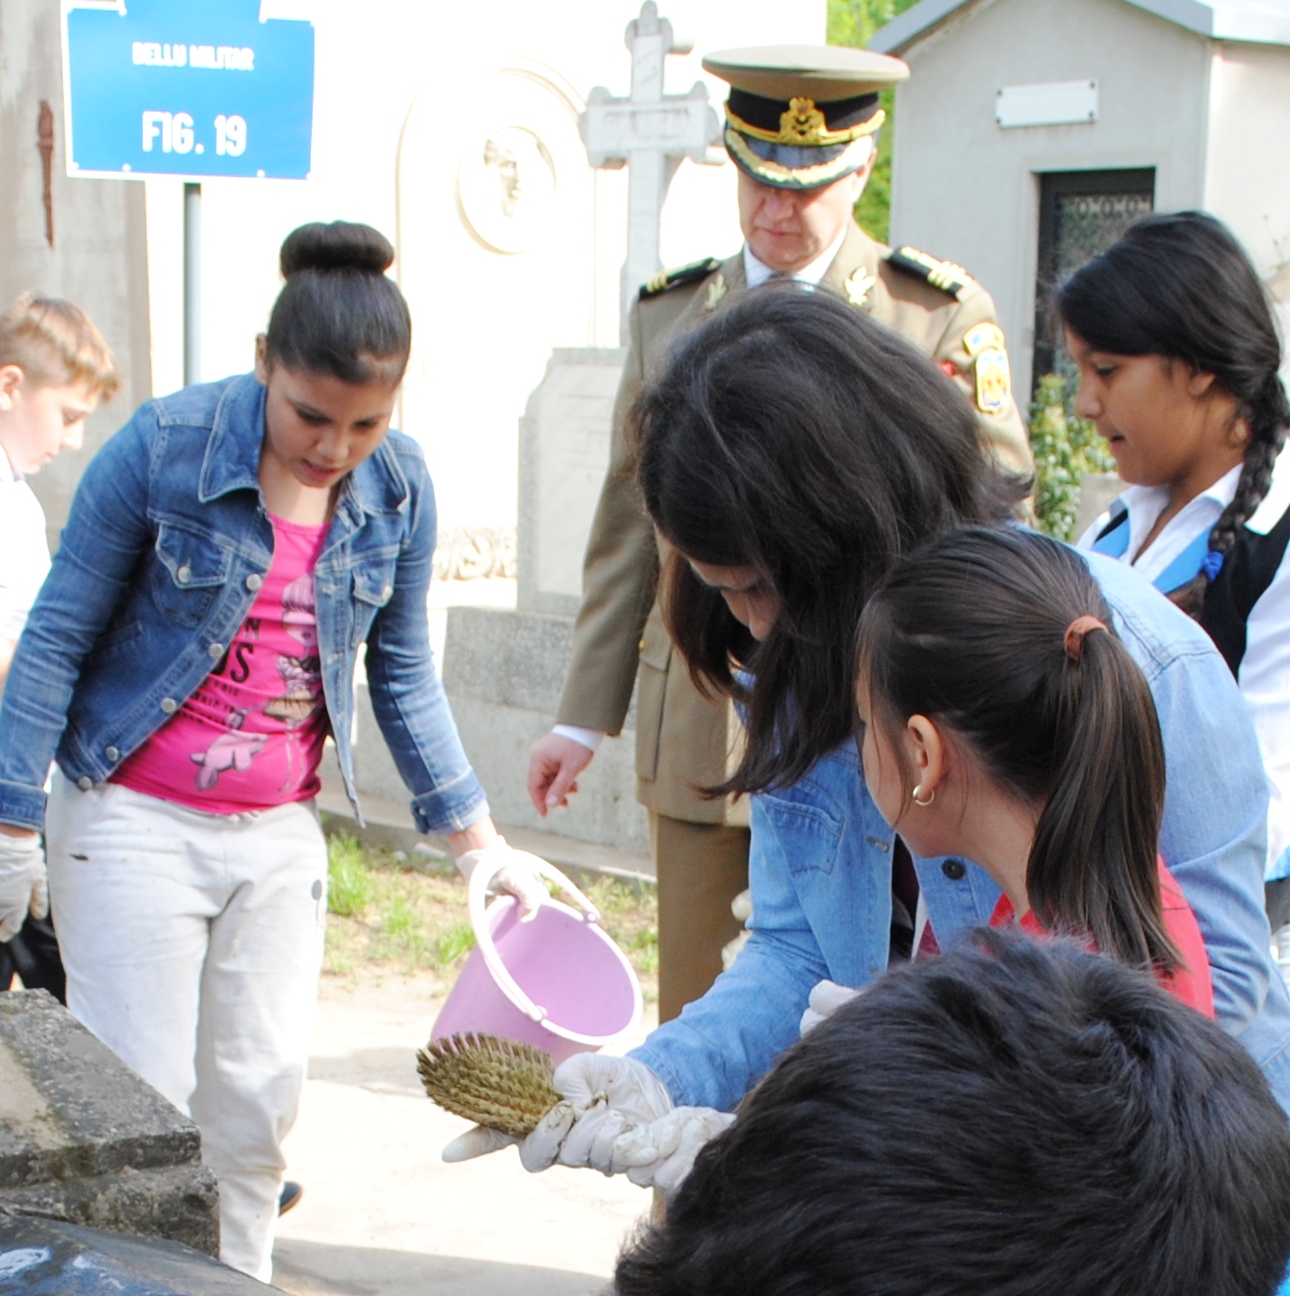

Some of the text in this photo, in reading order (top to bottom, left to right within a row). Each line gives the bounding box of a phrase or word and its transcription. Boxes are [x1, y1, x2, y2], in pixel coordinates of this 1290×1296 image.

[132, 42, 187, 67] BELLU
[142, 111, 248, 157] FIG. 19
